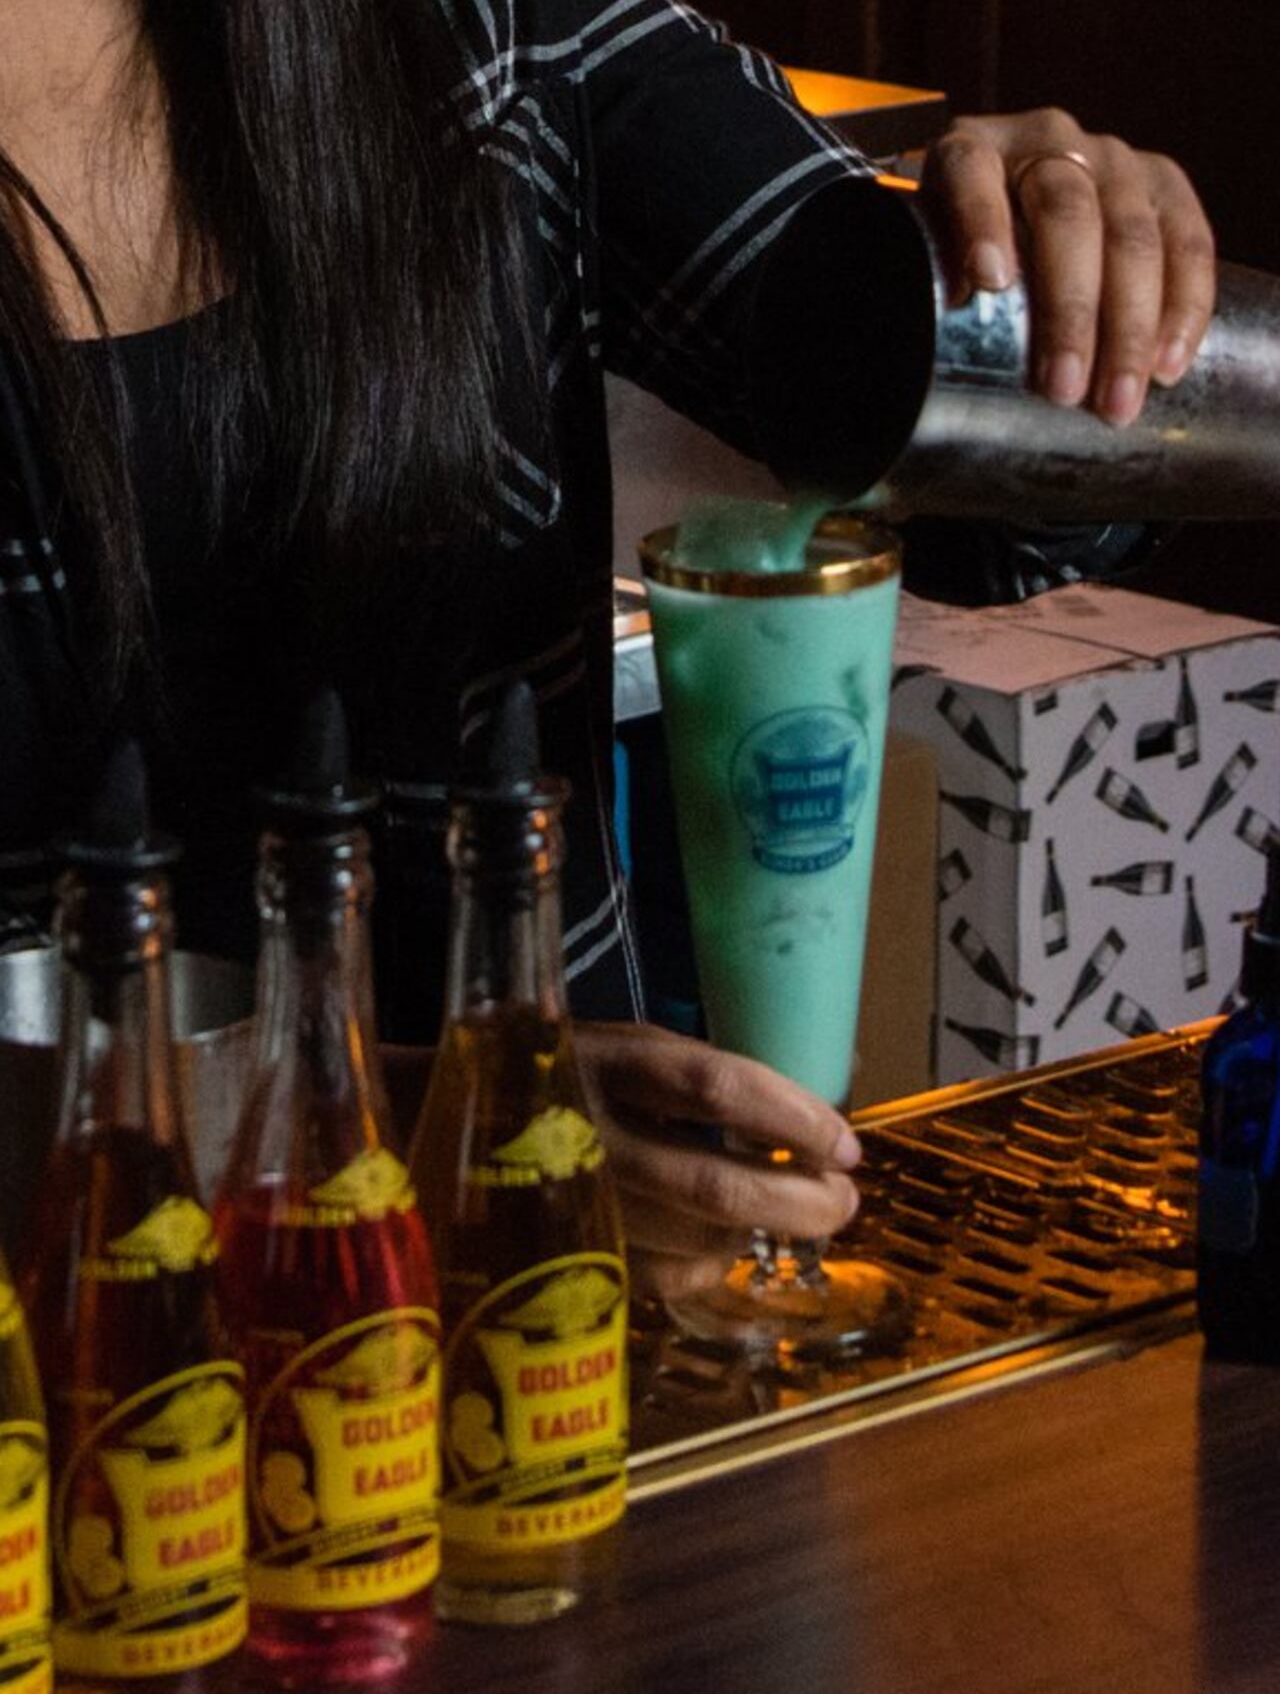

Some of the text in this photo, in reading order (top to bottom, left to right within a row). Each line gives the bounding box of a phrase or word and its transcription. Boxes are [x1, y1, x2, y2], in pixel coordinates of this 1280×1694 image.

[517, 1344, 618, 1398] GOLDEN
[340, 1398, 438, 1449] GOLDEN
[529, 1397, 610, 1444] EAGLE
[353, 1450, 429, 1499] EAGLE
[158, 1520, 236, 1570] EAGLE
